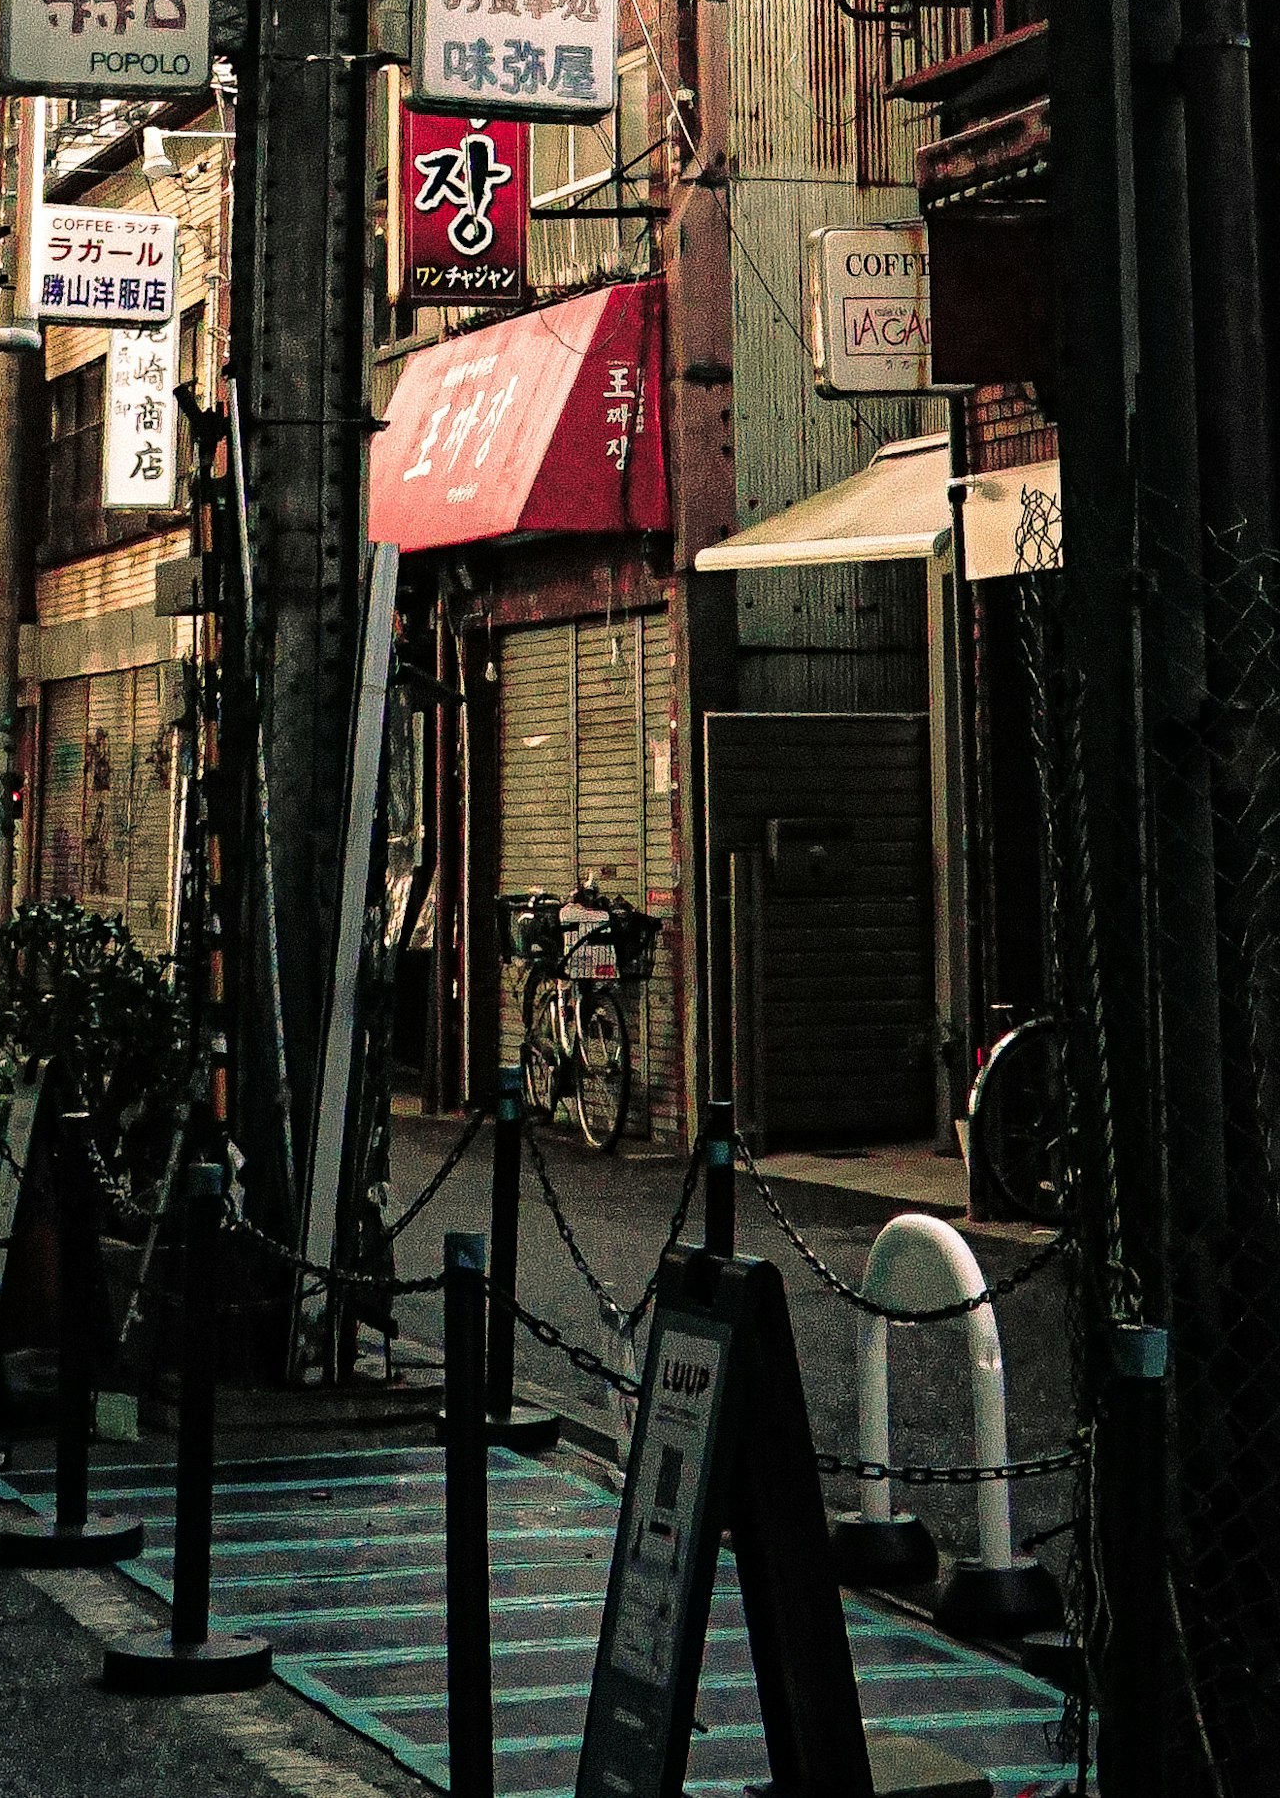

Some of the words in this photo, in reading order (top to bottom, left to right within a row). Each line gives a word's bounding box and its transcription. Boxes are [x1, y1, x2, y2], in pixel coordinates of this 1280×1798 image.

[90, 51, 190, 76] POPOLO
[444, 35, 598, 100] 味弥屋
[47, 236, 162, 266] ラガール
[42, 274, 166, 312] 勝山洋服店
[415, 265, 517, 289] ワンチャジャン
[662, 1359, 710, 1398] LUUP
